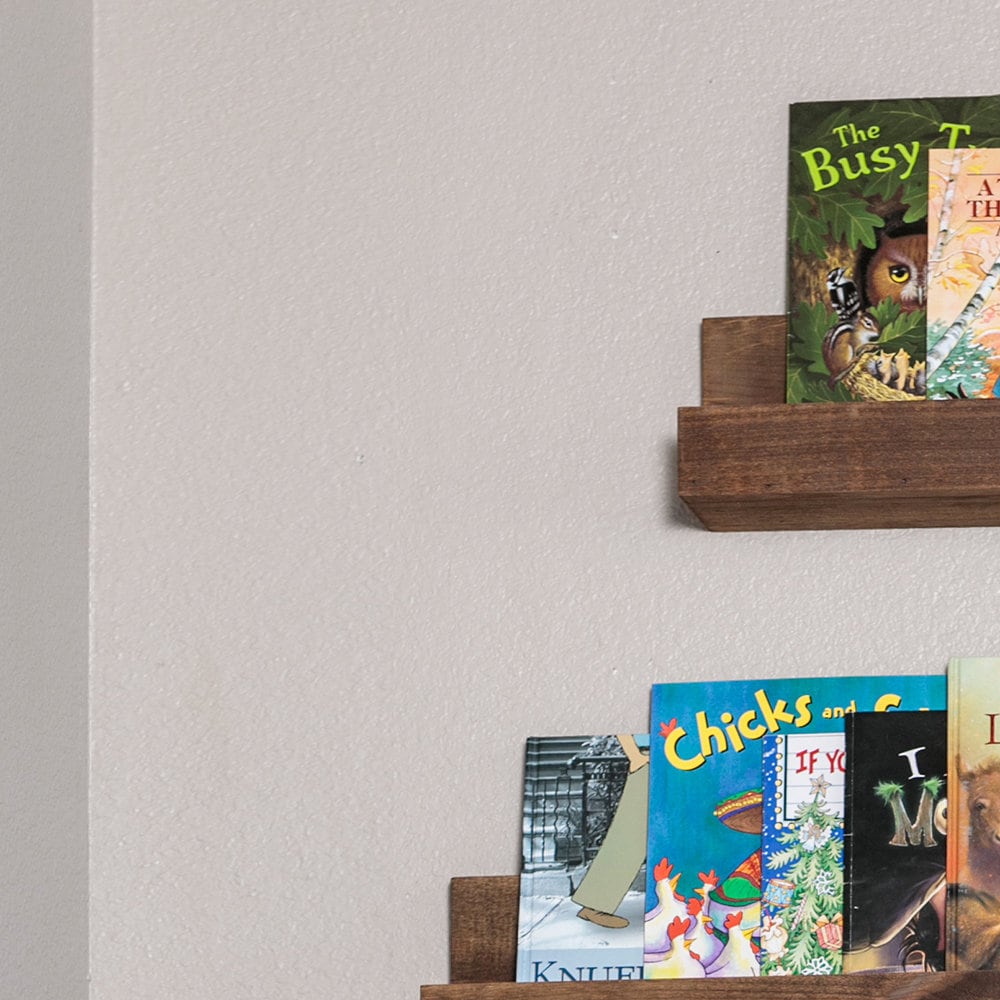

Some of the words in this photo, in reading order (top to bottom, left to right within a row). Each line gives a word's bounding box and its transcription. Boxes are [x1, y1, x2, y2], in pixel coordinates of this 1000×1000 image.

[833, 123, 880, 147] The
[801, 141, 920, 192] Busy
[939, 122, 977, 149] T
[977, 179, 994, 196] A
[663, 690, 813, 772] Chicks
[822, 700, 856, 719] and
[795, 749, 820, 775] IF
[898, 746, 926, 780] I
